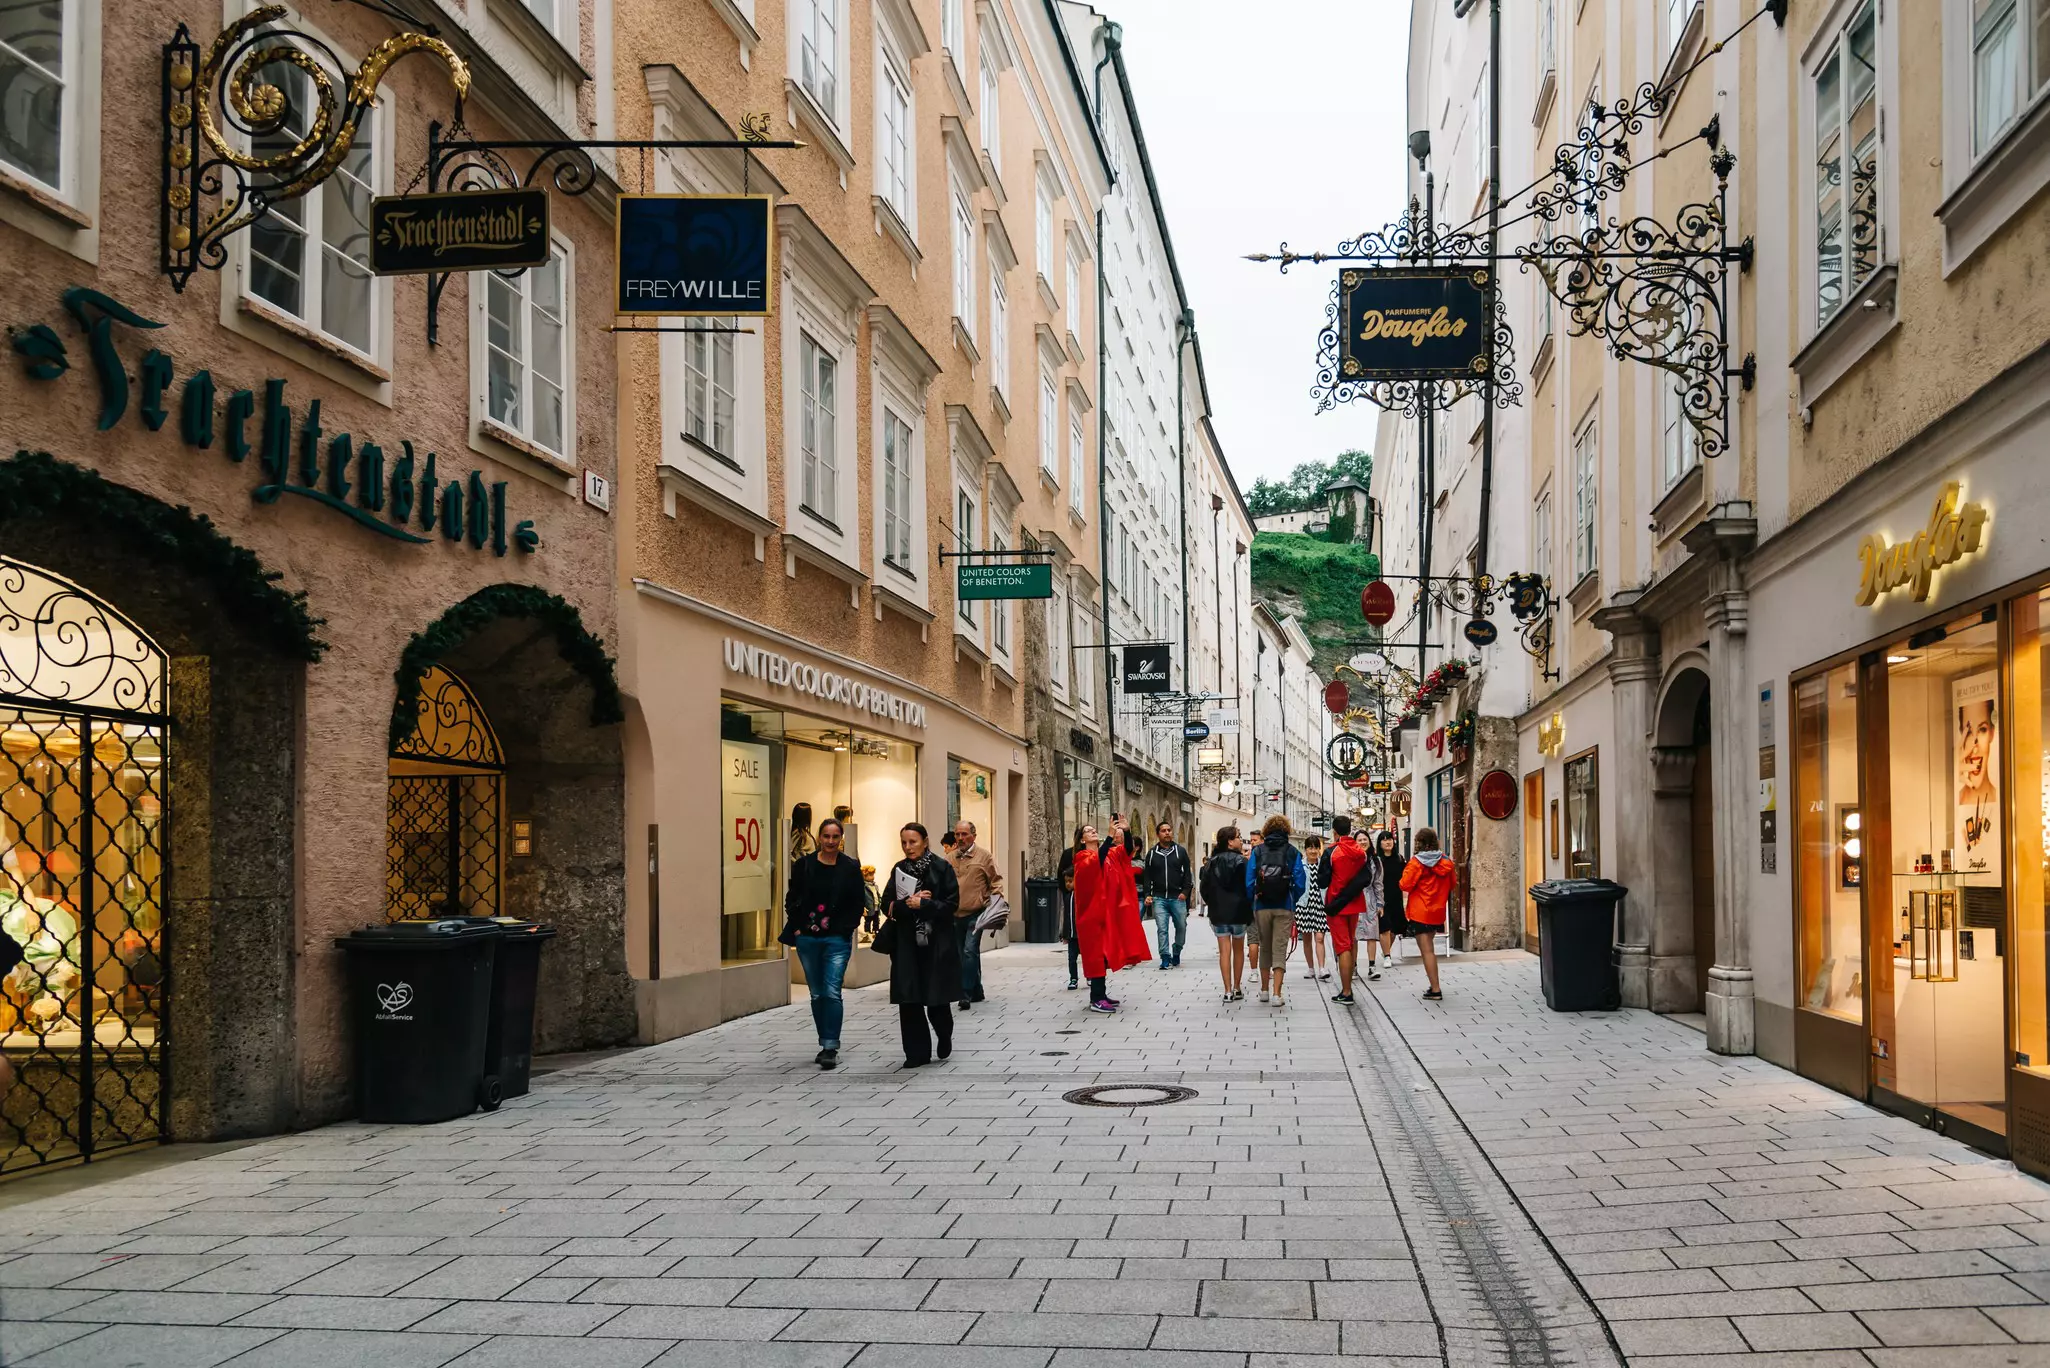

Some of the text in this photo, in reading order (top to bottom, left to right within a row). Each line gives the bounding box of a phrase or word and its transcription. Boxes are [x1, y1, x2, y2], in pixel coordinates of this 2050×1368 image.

[384, 203, 526, 257] Trachtenstadl
[626, 279, 761, 300] FREYWILLE
[1385, 307, 1432, 317] PARFUMERIE
[1360, 305, 1467, 347] Douglas
[61, 286, 509, 558] Trachtenstadl
[592, 476, 604, 497] 17
[1854, 479, 1987, 607] Douglas
[961, 567, 1032, 577] UNITED COLORS
[961, 577, 1025, 587] OF BENETTON.
[724, 637, 928, 730] UNITED COLORS OF BENETTON.
[1127, 672, 1166, 681] SWAROVSKI
[734, 758, 758, 779] SALE
